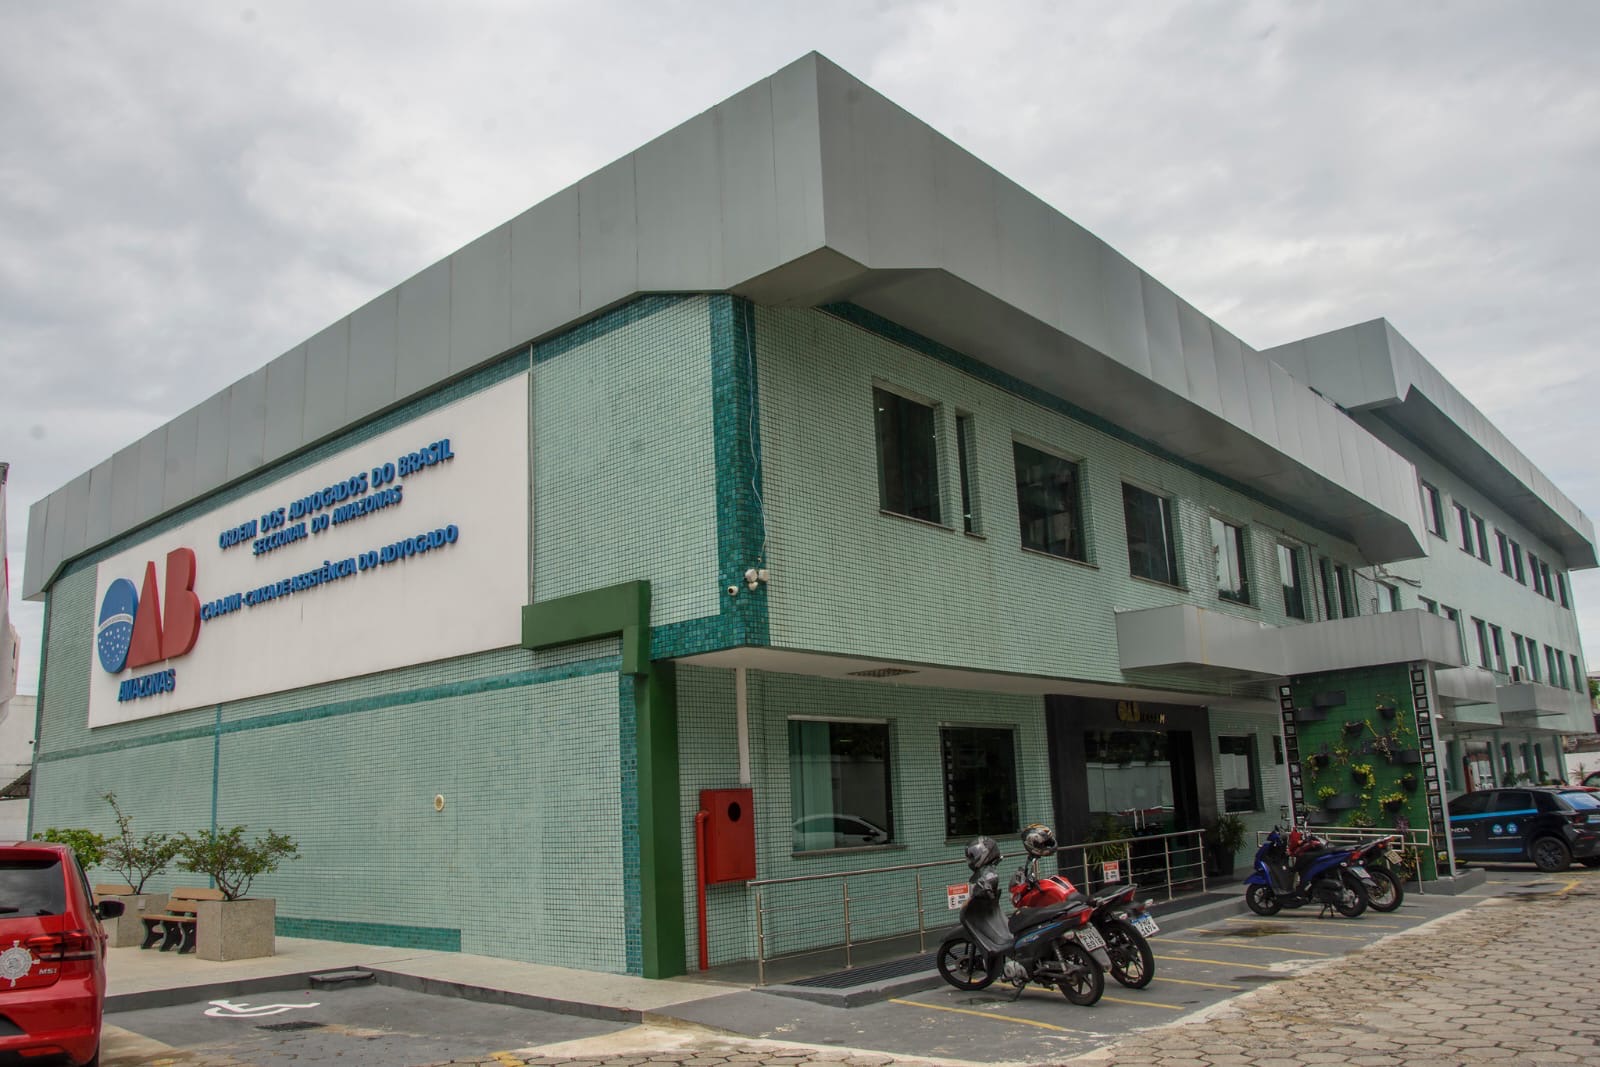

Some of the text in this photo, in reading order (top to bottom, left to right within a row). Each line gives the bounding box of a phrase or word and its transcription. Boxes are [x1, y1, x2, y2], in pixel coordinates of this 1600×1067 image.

[218, 438, 455, 550] ORDEM DOS ADVOGADOS DO BRASIL
[252, 484, 403, 556] SECCIONAL DO AMAZONAS
[244, 584, 276, 607] CAIXA
[276, 578, 291, 598] DE
[290, 560, 358, 593] ASSISTÊNCIA
[358, 550, 378, 571] DO
[379, 524, 459, 566] ADVOGADO
[118, 668, 176, 703] AMAZONAS
